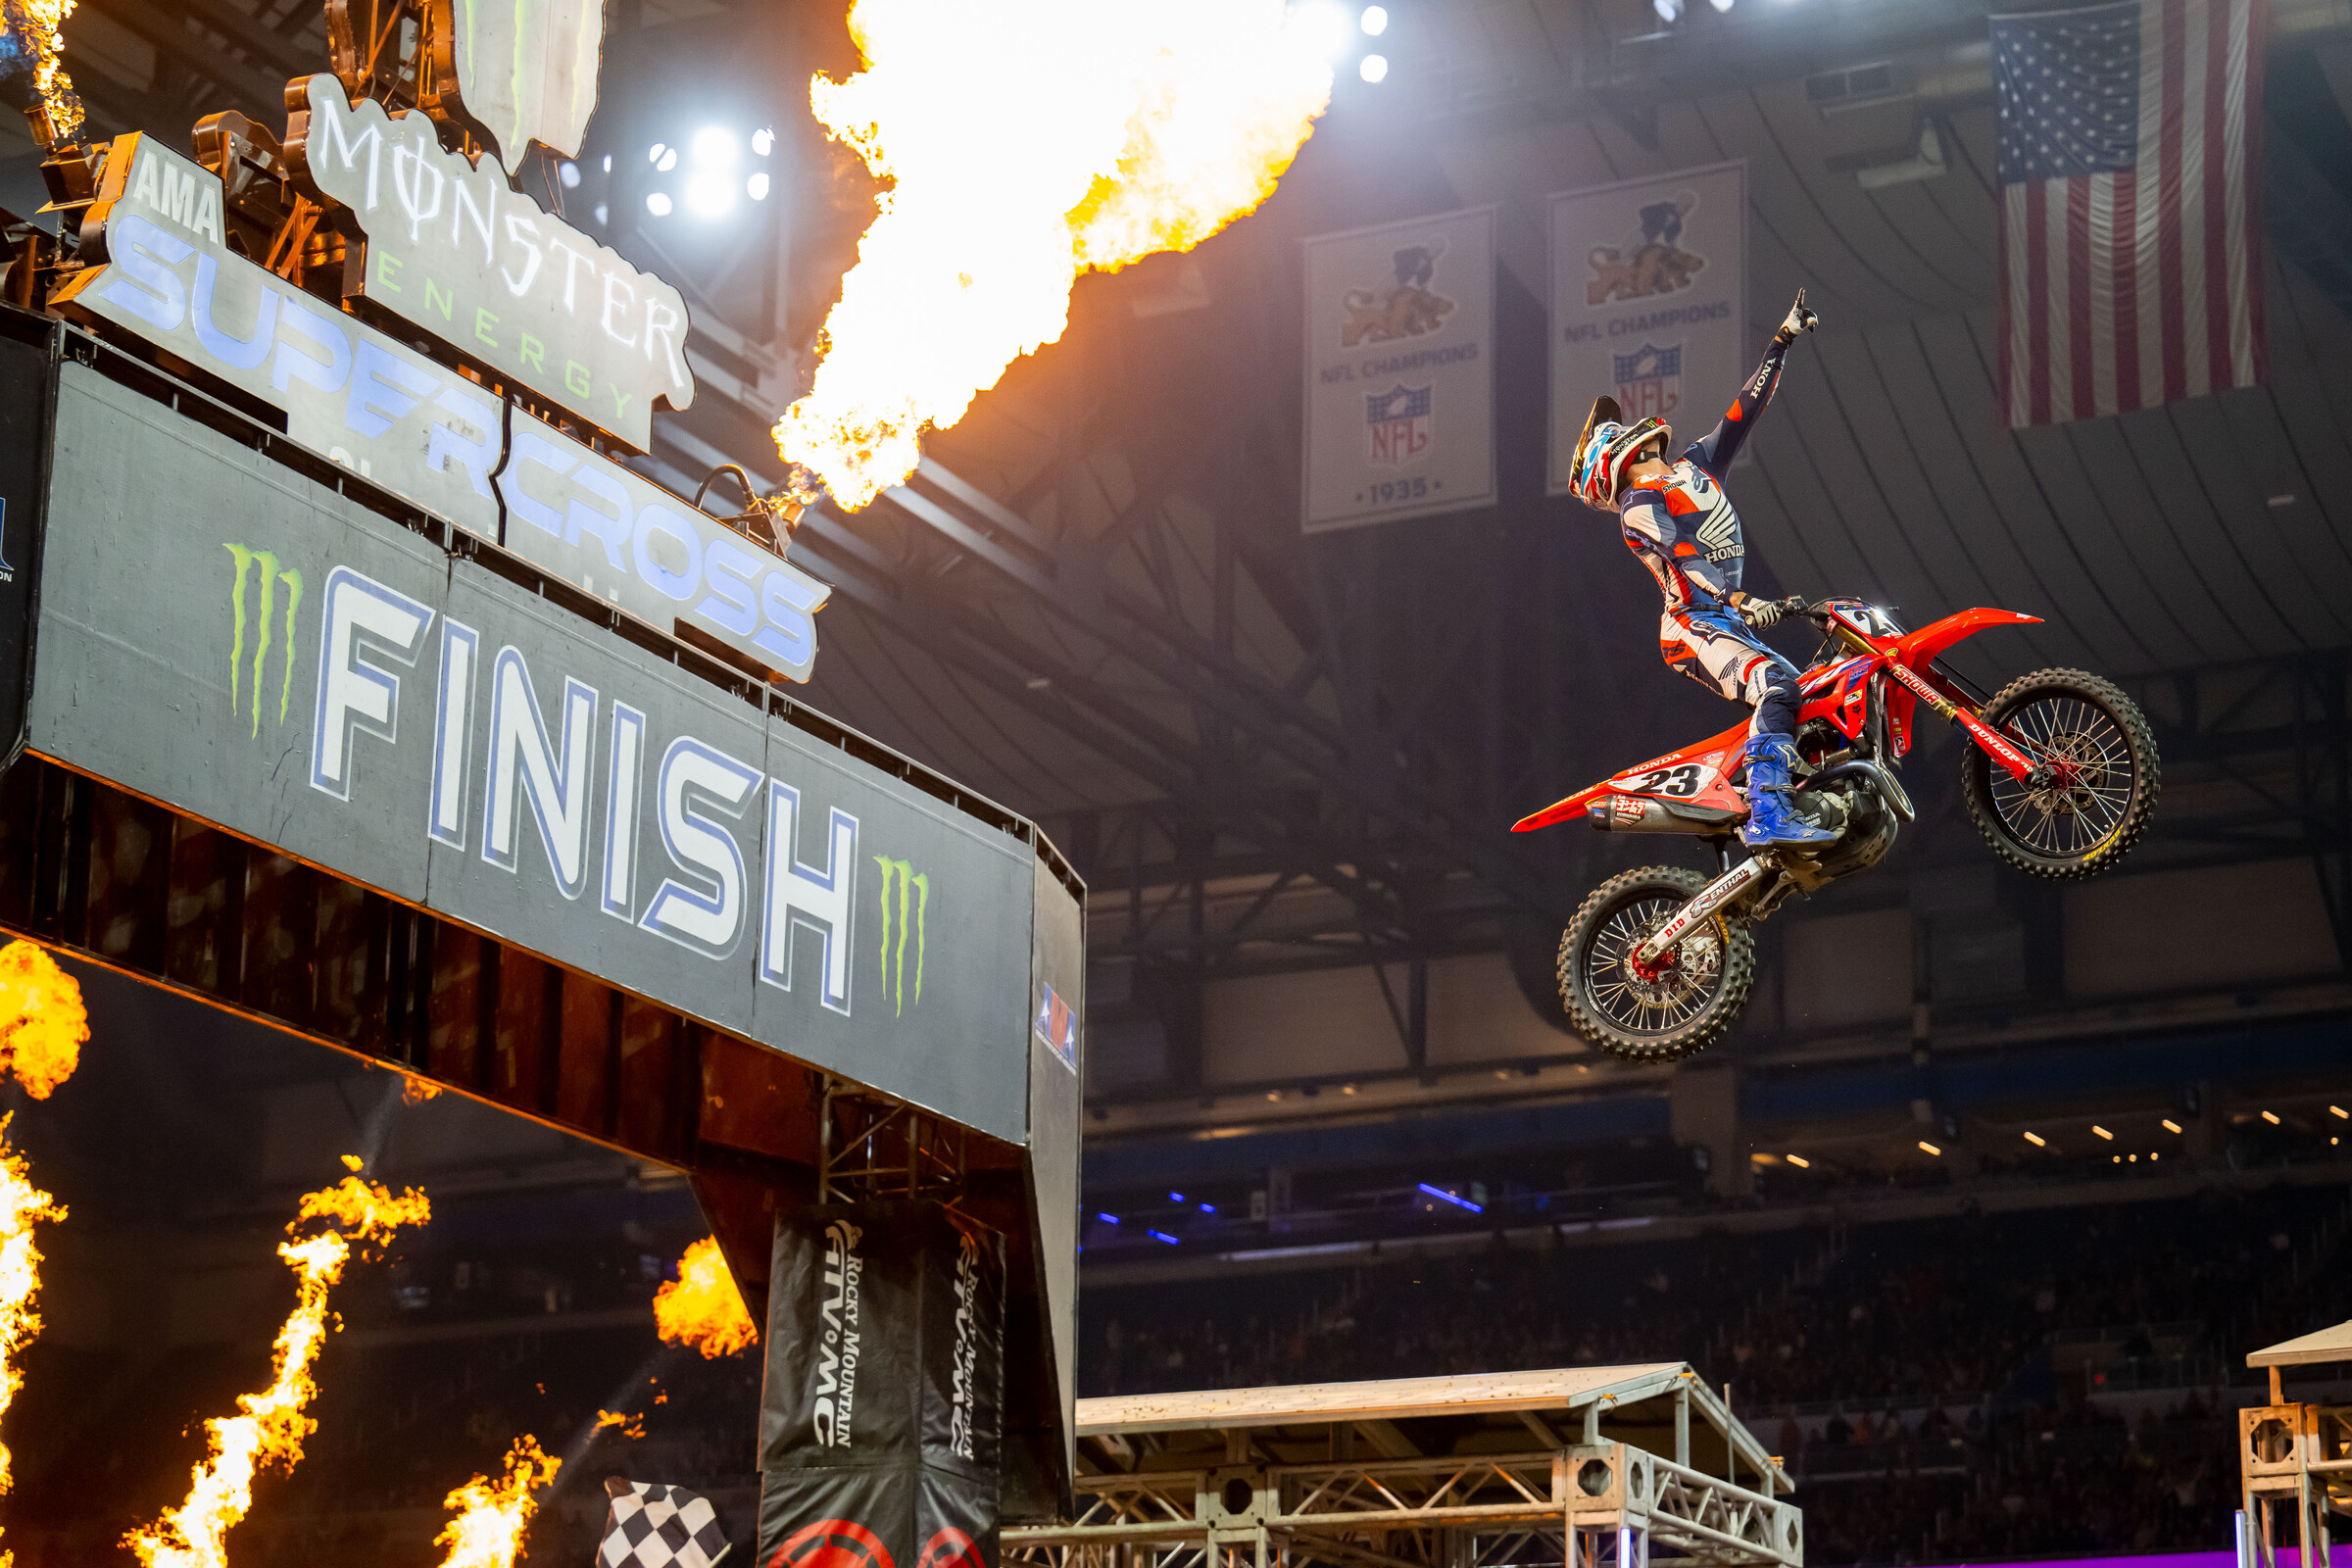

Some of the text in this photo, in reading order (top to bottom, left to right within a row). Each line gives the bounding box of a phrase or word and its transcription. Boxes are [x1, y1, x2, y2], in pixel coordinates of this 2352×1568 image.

[133, 149, 220, 245] AMA
[319, 99, 685, 388] MONSTER
[377, 250, 632, 419] ENERGY
[1565, 301, 1731, 342] NFL CHAMPIONS
[1320, 342, 1479, 384] NFL CHAMPIONS
[1620, 378, 1679, 420] NFL
[99, 214, 818, 667] SUPERCROSS
[1372, 419, 1428, 460] NFL
[1370, 476, 1428, 504] 1935
[1662, 479, 1687, 493] SHOWA
[1893, 667, 1942, 706] SHOWA
[1968, 723, 2021, 762] DUNLOP
[1628, 753, 1683, 775] HONDA
[1633, 765, 1702, 797] 23
[311, 564, 859, 1017] FINISH
[1690, 869, 1749, 918] RENTHAL
[1664, 917, 1686, 938] DID
[837, 1253, 863, 1448] ROCKY MOUNTAIN
[962, 1269, 980, 1461] ROCKY MOUNTAIN
